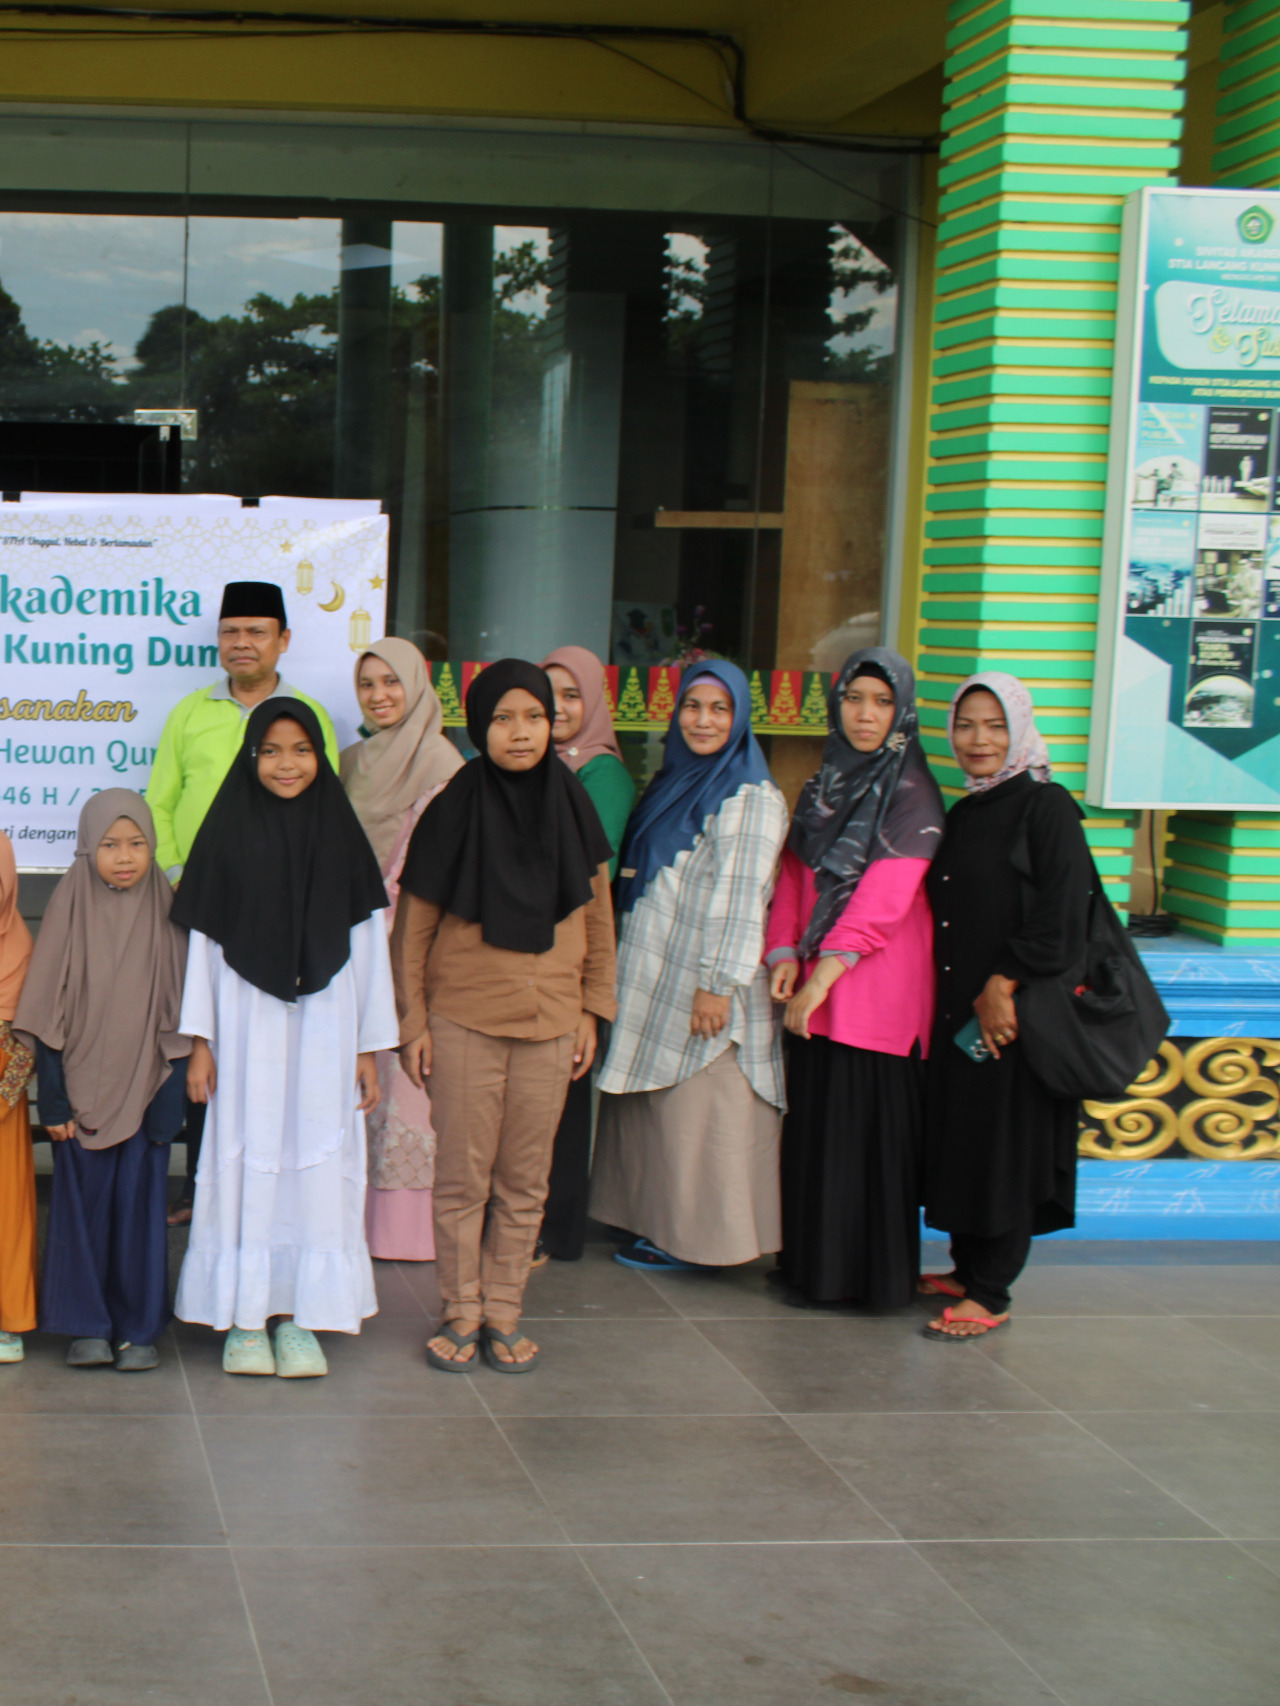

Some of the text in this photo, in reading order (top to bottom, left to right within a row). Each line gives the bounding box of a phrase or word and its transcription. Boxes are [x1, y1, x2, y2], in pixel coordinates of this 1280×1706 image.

[1168, 258, 1194, 269] STIA
[1196, 259, 1248, 271] LANCANG
[1209, 327, 1231, 352] &
[90, 537, 97, 546] &
[4, 632, 134, 675] Kuning
[42, 787, 58, 805] H
[68, 787, 81, 806] /
[18, 825, 76, 844] dengan
